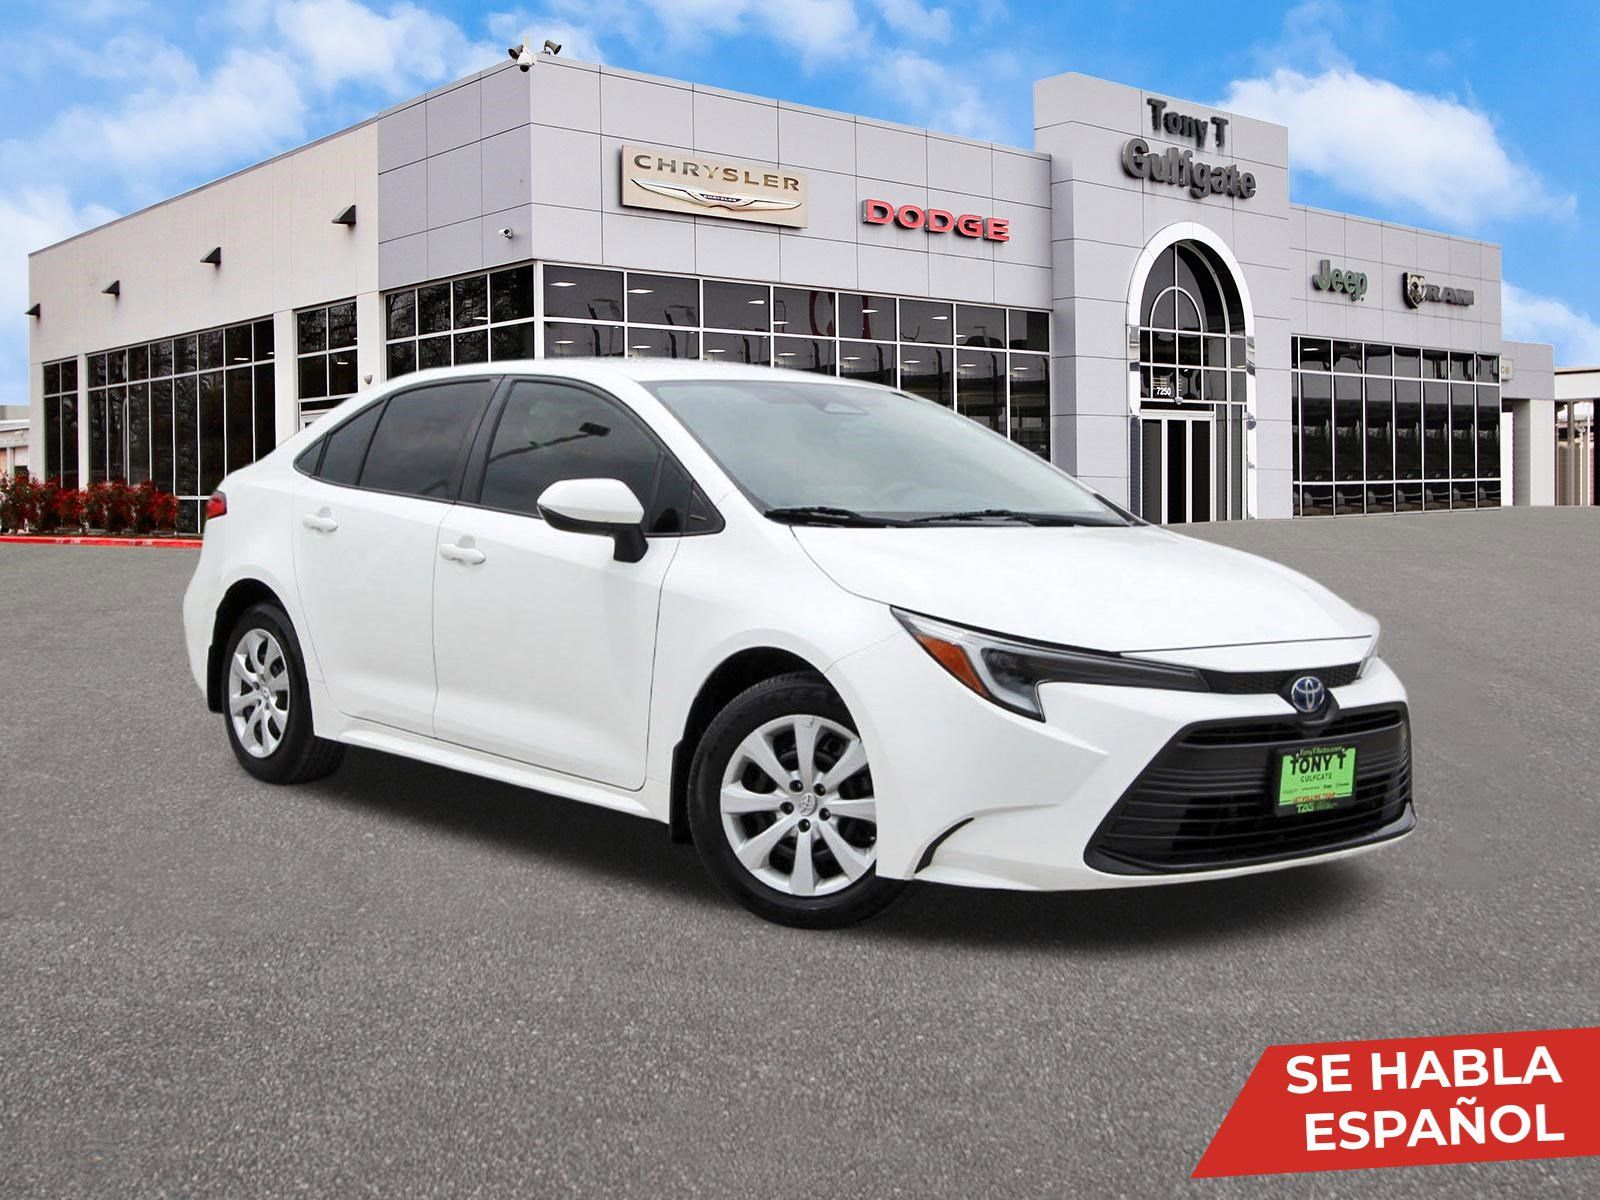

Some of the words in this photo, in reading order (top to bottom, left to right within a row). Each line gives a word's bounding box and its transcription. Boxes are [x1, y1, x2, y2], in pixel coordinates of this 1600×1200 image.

[1147, 98, 1208, 147] Tony
[1211, 117, 1229, 148] T
[634, 153, 800, 192] CHRYSLER
[1120, 137, 1257, 199] Gulfgate
[862, 199, 1010, 242] DODGE
[1312, 259, 1368, 302] Jeep
[1424, 284, 1475, 307] RAM
[1290, 754, 1333, 775] TONY
[1337, 751, 1347, 770] T
